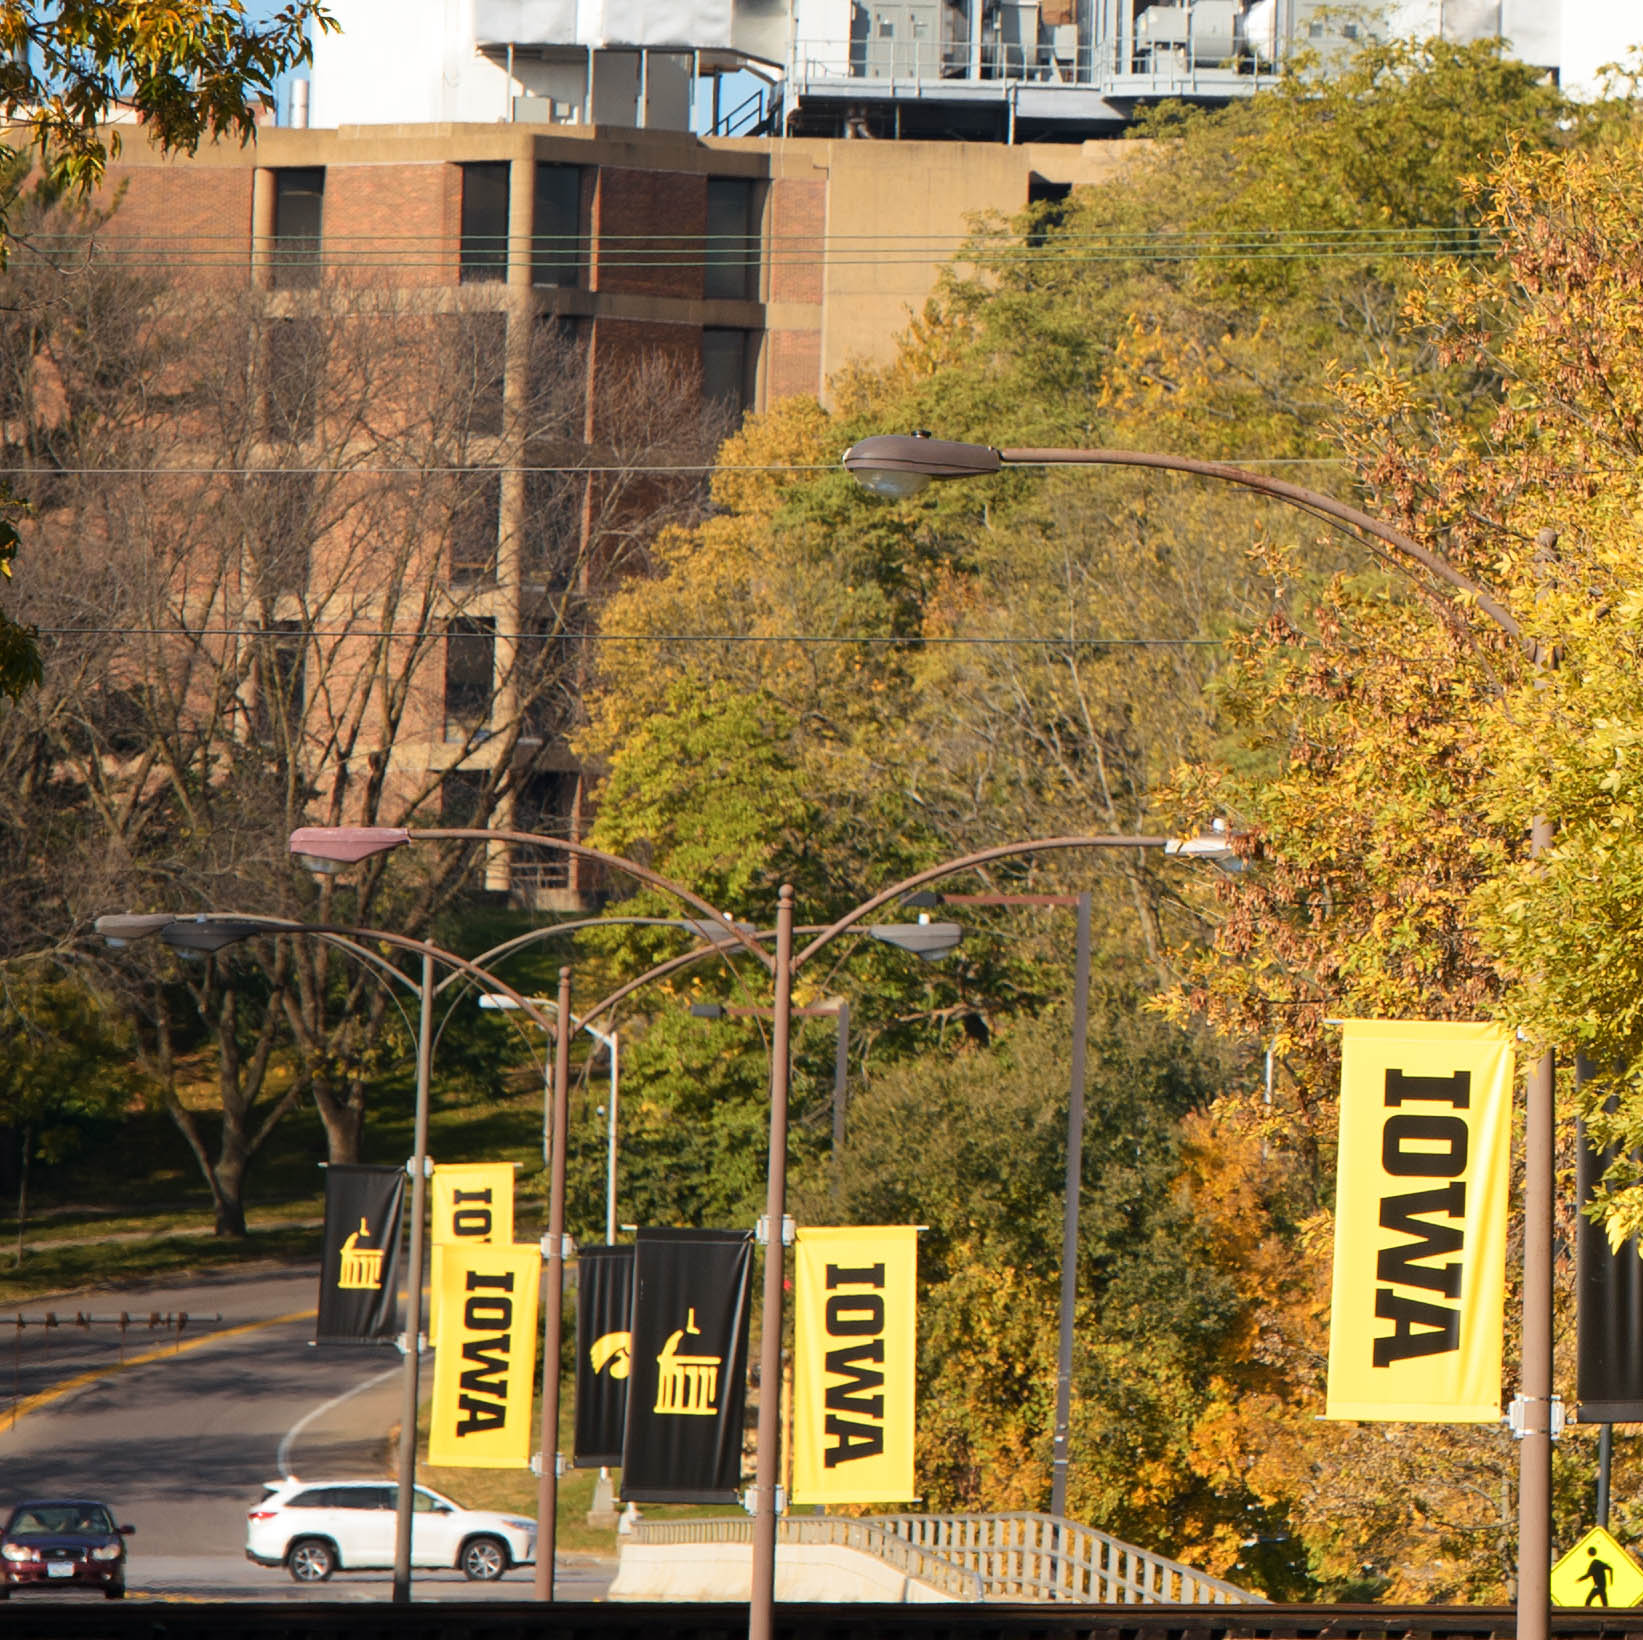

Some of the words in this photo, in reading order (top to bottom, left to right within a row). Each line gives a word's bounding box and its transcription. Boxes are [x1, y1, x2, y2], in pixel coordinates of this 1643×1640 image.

[454, 1188, 493, 1243] IO
[1372, 1067, 1471, 1368] IOWA
[456, 1270, 515, 1438] IOWA
[825, 1263, 885, 1469] IOWA
